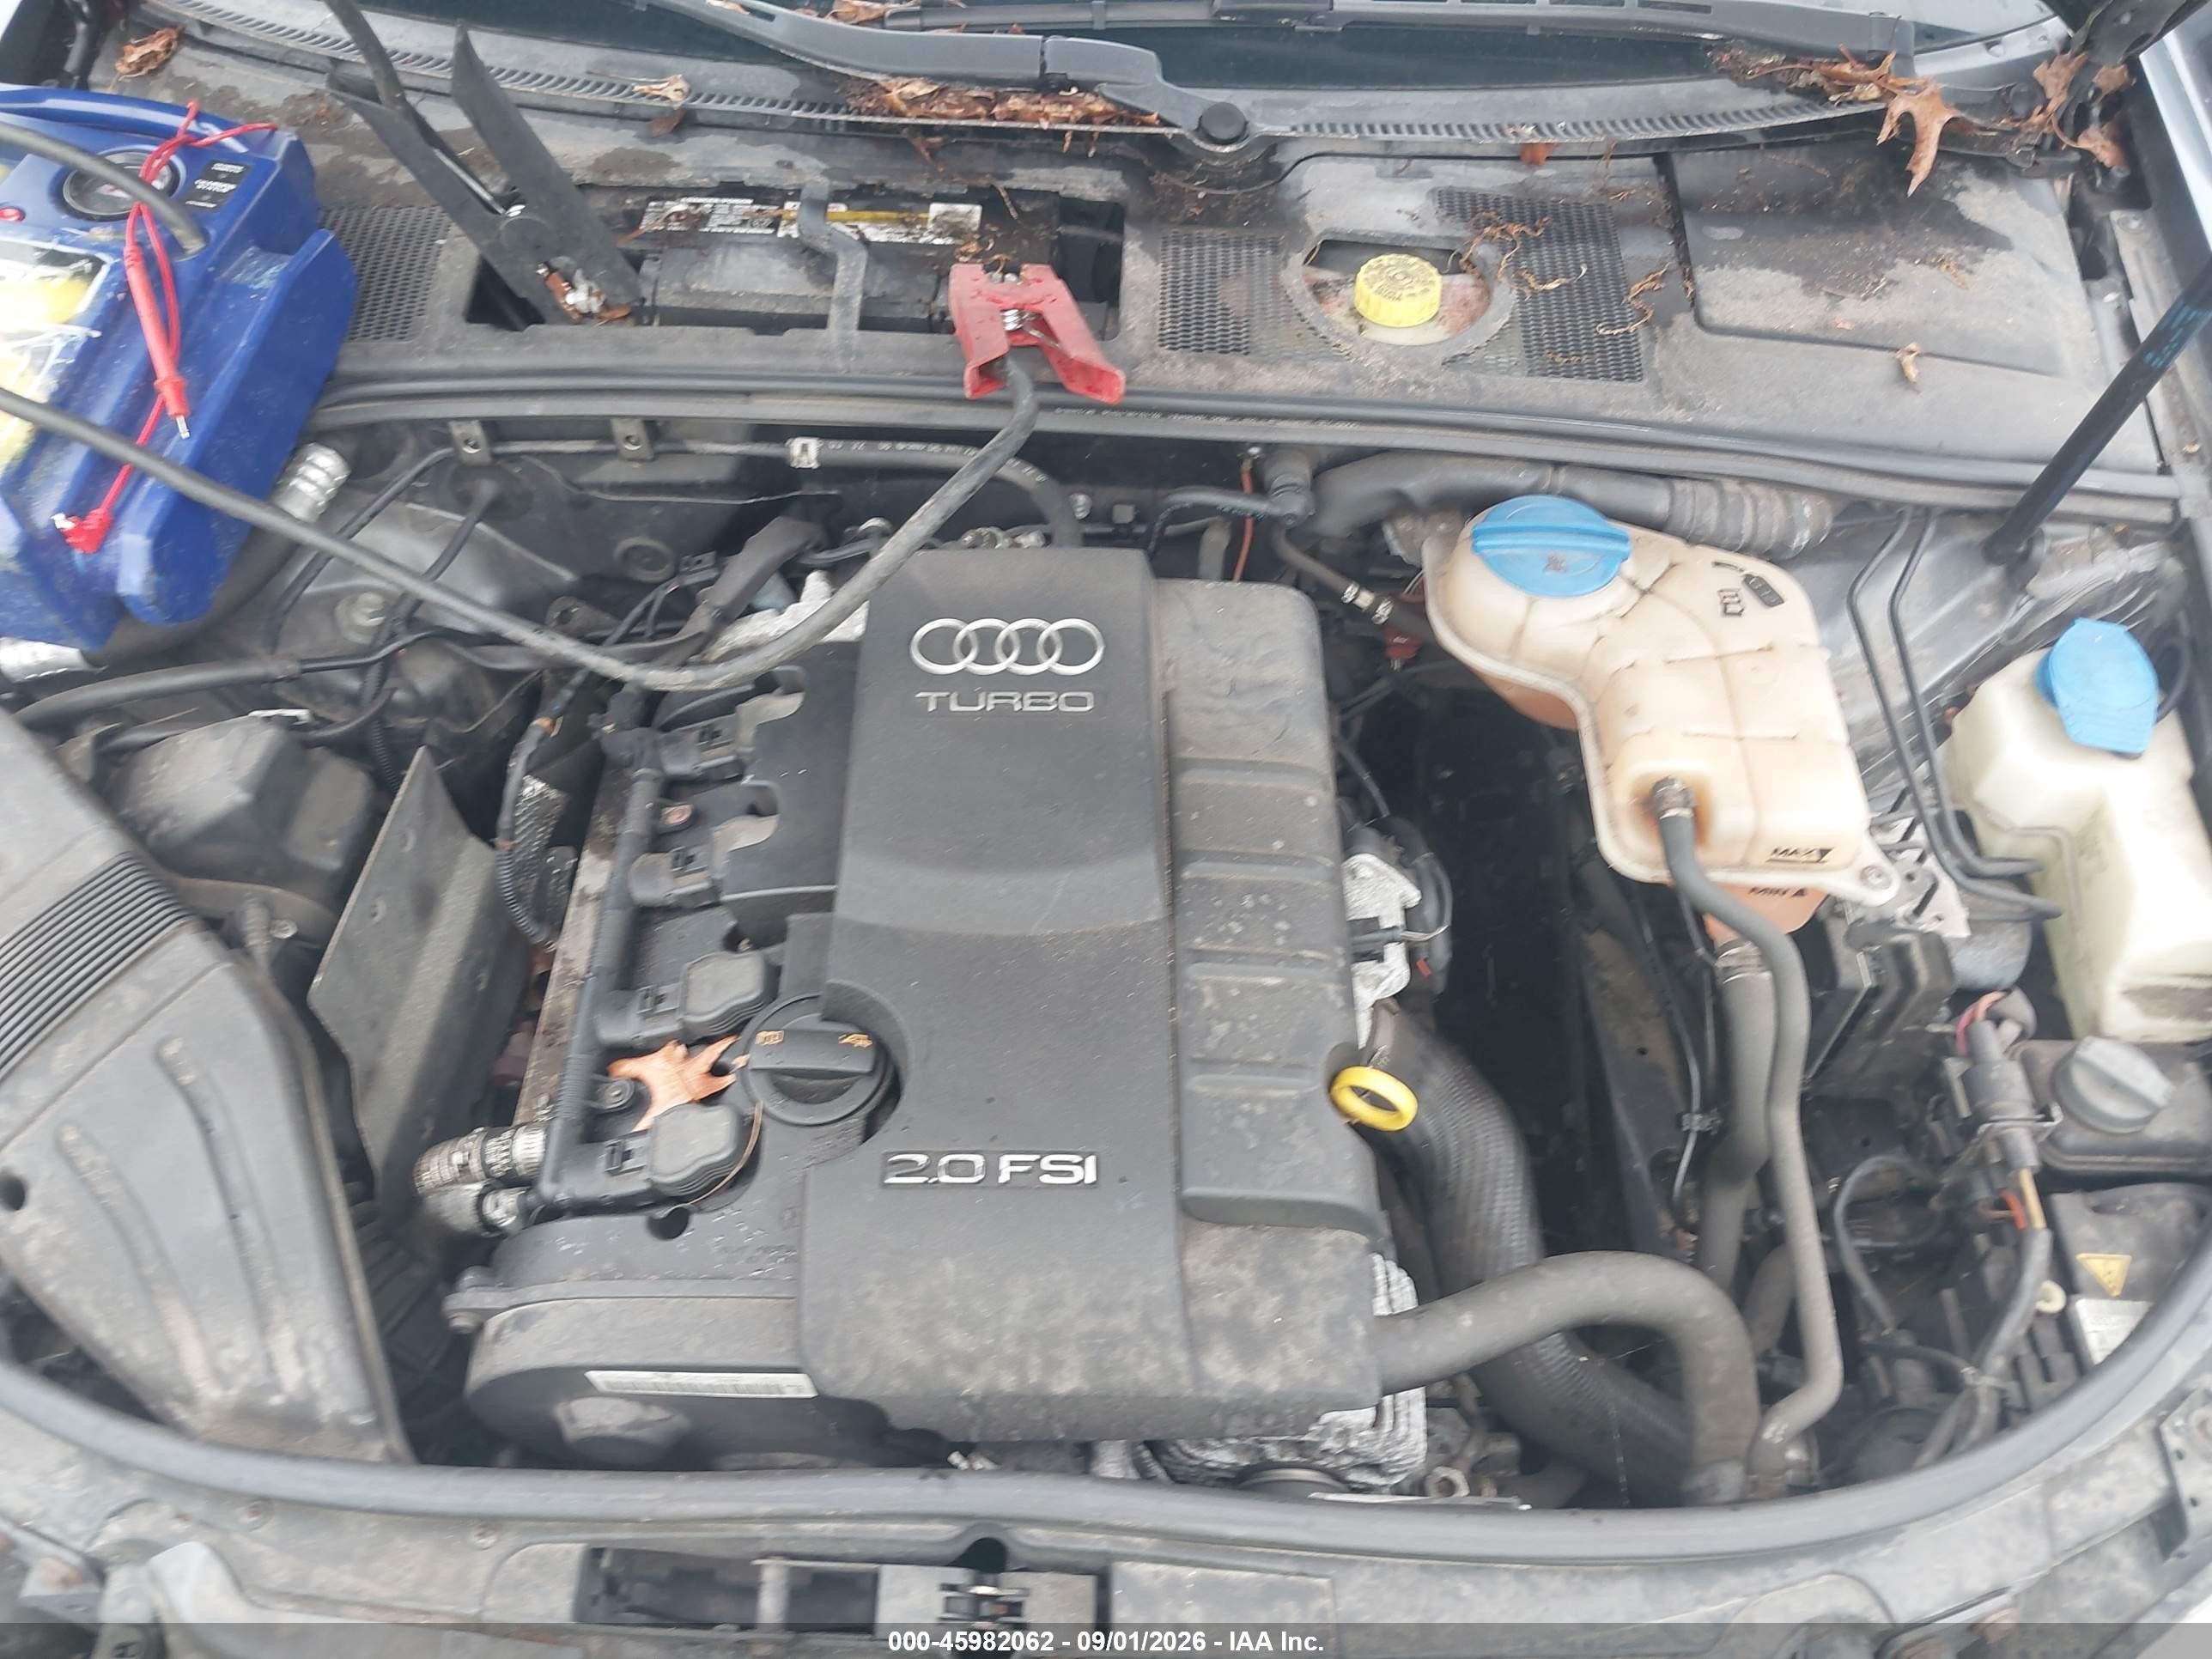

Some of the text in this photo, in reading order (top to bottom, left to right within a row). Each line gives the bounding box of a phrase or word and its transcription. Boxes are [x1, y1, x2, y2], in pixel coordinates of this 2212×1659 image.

[915, 691, 1095, 712] TURBO
[884, 1153, 1097, 1185] 2.0 FSI
